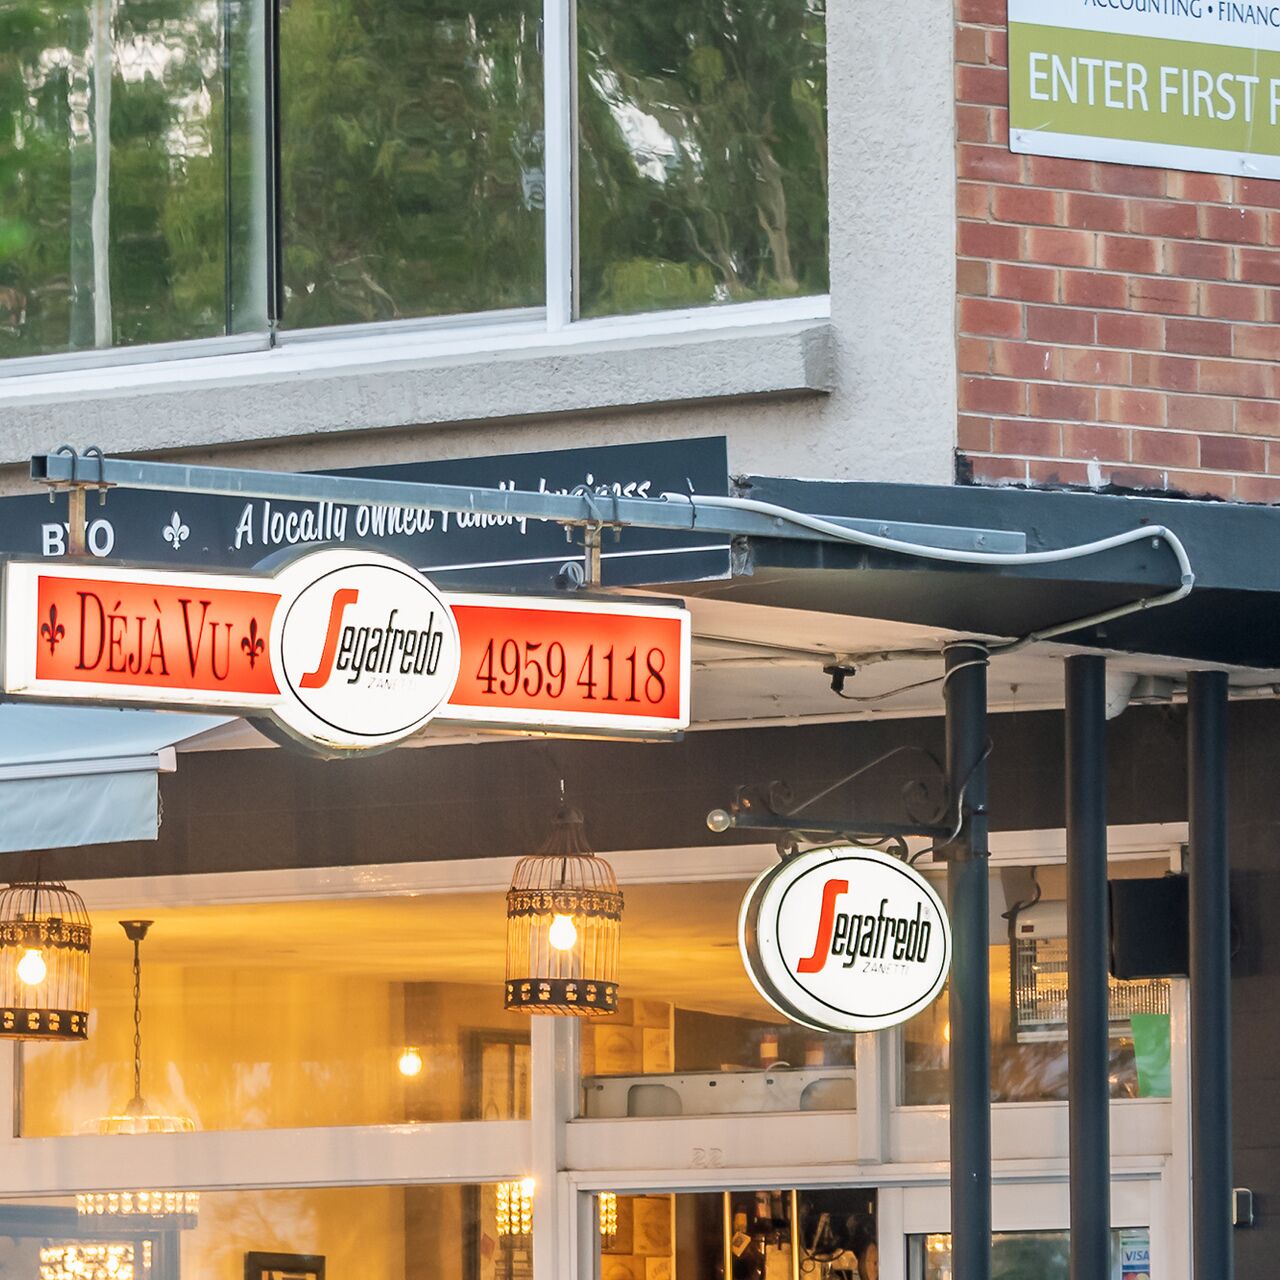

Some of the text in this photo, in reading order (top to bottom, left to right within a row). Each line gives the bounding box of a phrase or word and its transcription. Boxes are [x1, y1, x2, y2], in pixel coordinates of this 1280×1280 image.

[1028, 51, 1149, 112] ENTER
[1160, 66, 1260, 123] FIRST
[42, 519, 115, 558] BO
[235, 503, 253, 549] A
[261, 501, 349, 546] locally
[76, 590, 234, 681] DÉJÀ VU
[299, 588, 444, 689] Segafredo
[476, 637, 667, 704] 4959 4118
[796, 878, 932, 974] Segafredo
[1125, 1250, 1150, 1262] VISA
